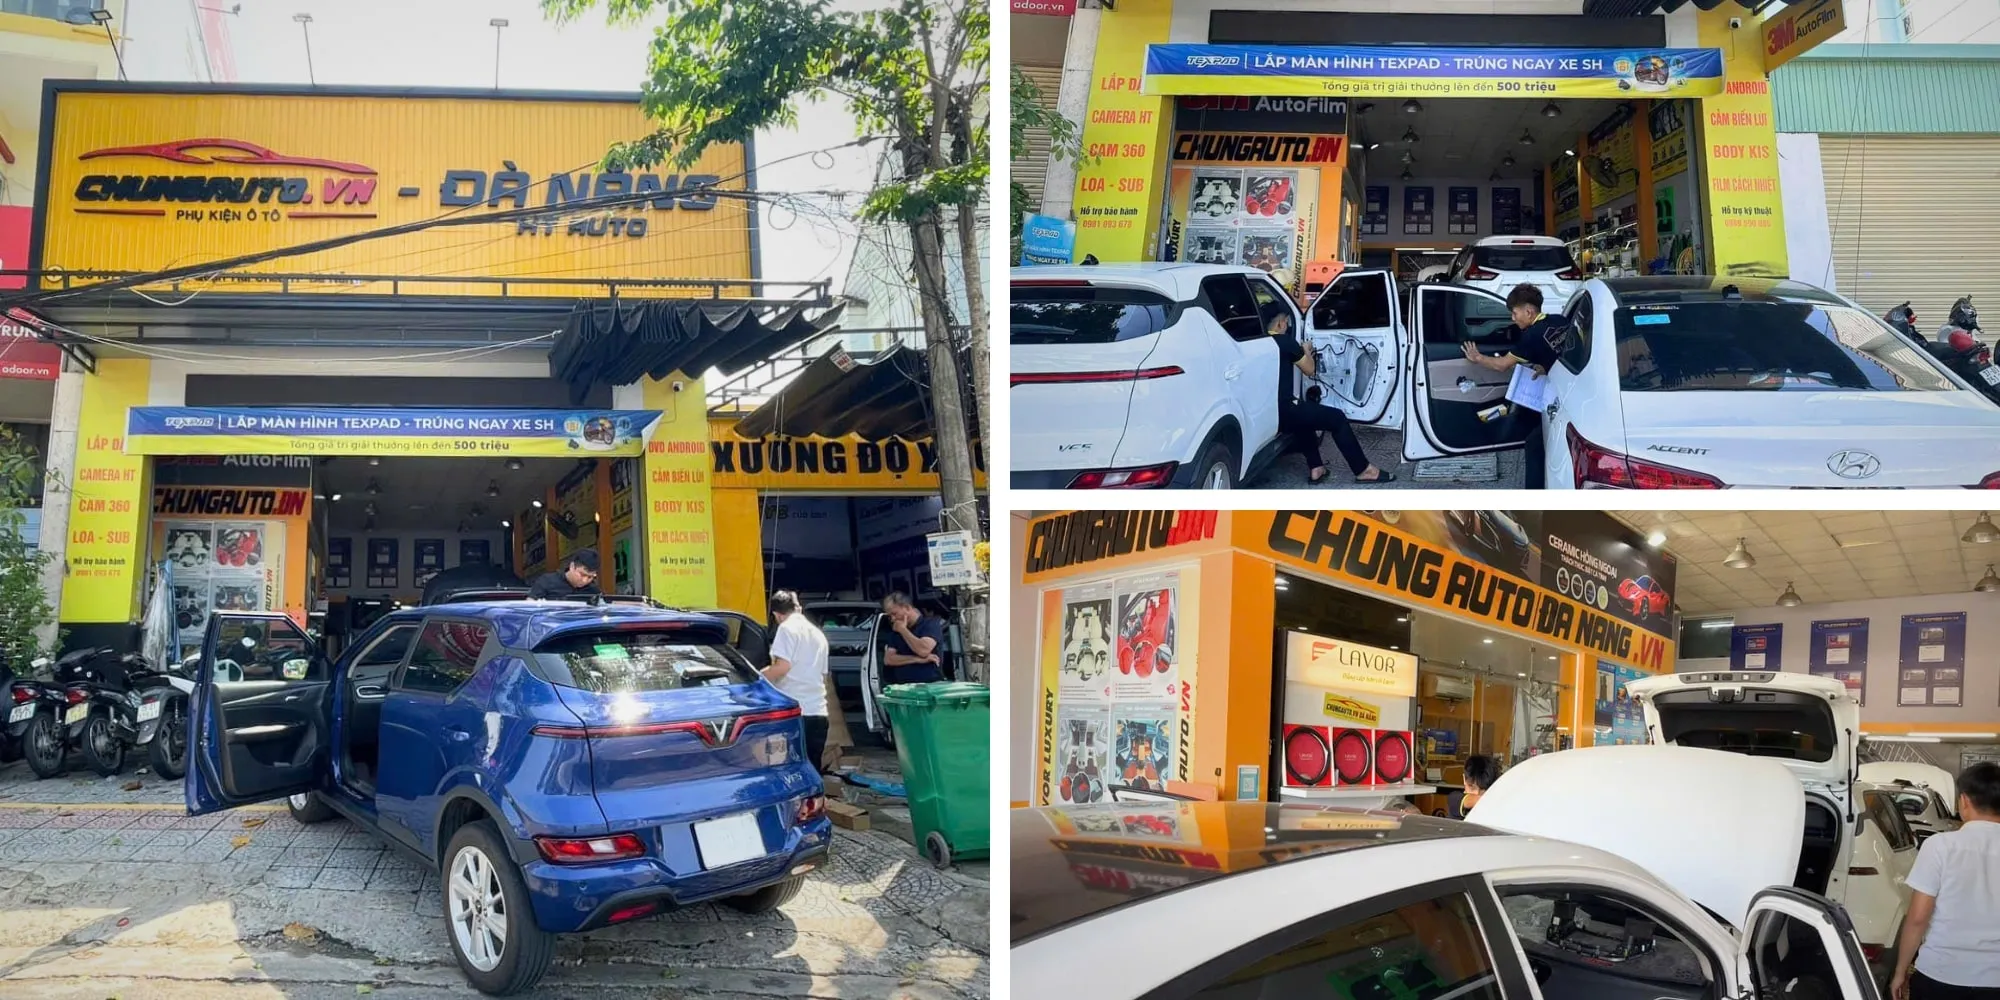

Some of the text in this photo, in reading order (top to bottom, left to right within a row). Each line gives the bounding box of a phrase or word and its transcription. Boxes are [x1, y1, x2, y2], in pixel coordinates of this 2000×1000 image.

[1768, 7, 1837, 56] 3M AutoFilm
[1186, 56, 1240, 68] TEXPAD
[1254, 52, 1287, 68] LẮP
[1291, 53, 1328, 69] MÀN
[1333, 53, 1374, 69] HÌNH
[1378, 58, 1440, 70] TEXPAD
[1454, 55, 1508, 70] TRÚNG
[1512, 58, 1554, 71] NGAY
[1558, 58, 1578, 71] XE
[1582, 59, 1603, 71] SH
[1101, 73, 1125, 91] LẮP
[1322, 80, 1349, 92] Tổng
[1373, 81, 1385, 92] trị
[1453, 81, 1470, 91] lên
[1473, 81, 1494, 92] đến
[1497, 81, 1522, 92] 500
[1525, 81, 1556, 93] triệu
[1726, 81, 1768, 95] ANDROID
[1255, 95, 1347, 114] AutoFilm
[1091, 110, 1153, 124] CAMERA HT
[1710, 109, 1730, 126] CẢM
[1732, 109, 1752, 127] BIẾN
[1089, 143, 1146, 158] CAM 360
[1713, 145, 1770, 159] BODY KIS
[74, 175, 377, 204] CHUNGAUTO.VN
[440, 160, 530, 207] ĐÀ
[1080, 177, 1105, 192] LOA
[1118, 177, 1144, 192] SUB
[1712, 176, 1776, 195] FILM CÁCH NHIỆT
[176, 208, 281, 223] PHỤ KIỆN Ô TÔ
[1092, 207, 1103, 217] trợ
[1119, 207, 1138, 216] hành
[567, 217, 648, 238] AUTO
[165, 416, 215, 429] TEXPAD
[261, 414, 296, 429] MÀN
[306, 414, 338, 429] HÌNH
[342, 417, 401, 429] TEXPAD
[414, 416, 464, 430] TRÚNG
[468, 418, 509, 431] NGAY
[512, 419, 530, 431] XE
[534, 419, 554, 431] SH
[454, 440, 477, 450] 500
[480, 440, 510, 452] triệu
[648, 440, 706, 454] DVD ANDROID
[711, 431, 847, 474] XƯỞNG
[1647, 444, 1712, 456] ACCENT
[79, 467, 136, 482] CAMERA HT
[78, 498, 130, 512] CAM 360
[654, 500, 705, 514] BODY KIS
[72, 529, 94, 543] LOA
[107, 530, 130, 544] SUB
[1548, 533, 1580, 561] CERAMIC
[1267, 510, 1444, 600] CHUNG
[1443, 556, 1535, 629] AUTO
[1339, 647, 1395, 674] LAVOR
[1043, 686, 1054, 763] LUXURY
[1178, 679, 1192, 785] AUTO.VN
